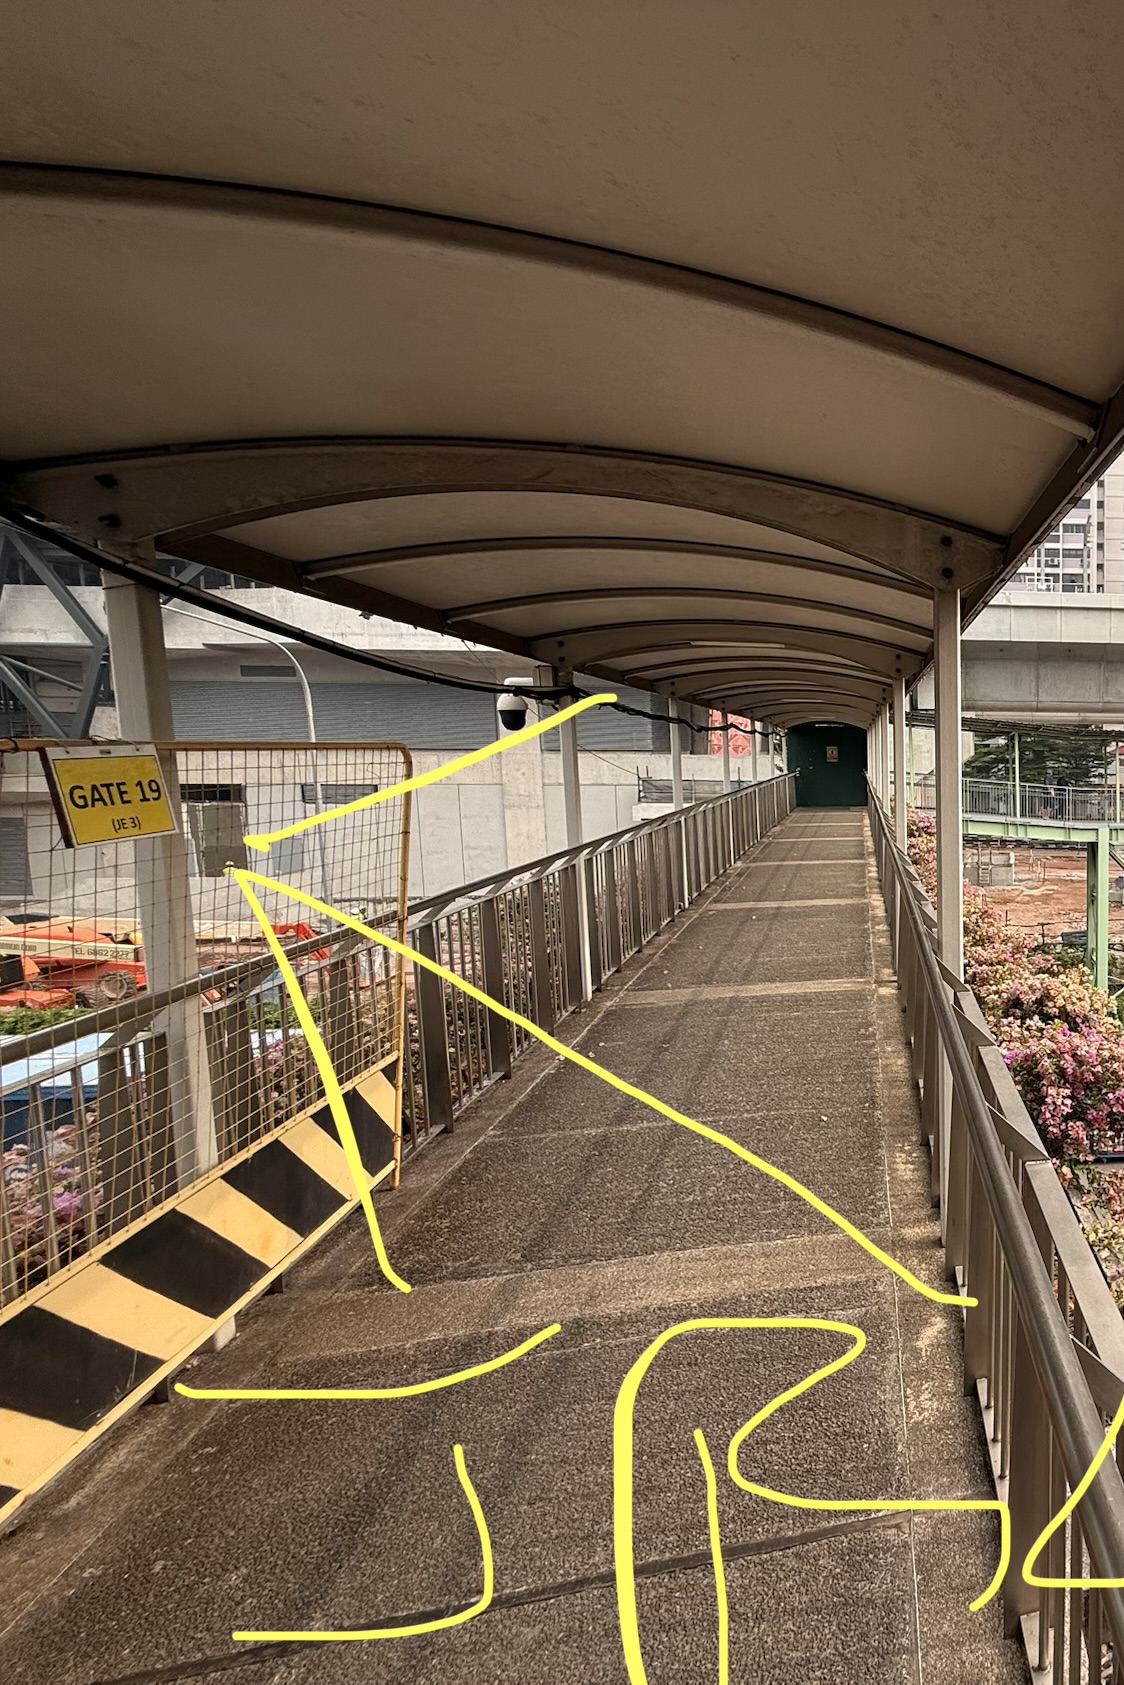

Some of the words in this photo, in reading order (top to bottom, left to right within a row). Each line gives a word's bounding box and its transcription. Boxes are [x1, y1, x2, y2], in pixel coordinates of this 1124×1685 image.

[68, 780, 132, 810] GATE
[135, 778, 162, 803] 19
[111, 816, 129, 833] (JE
[129, 815, 142, 831] 3)
